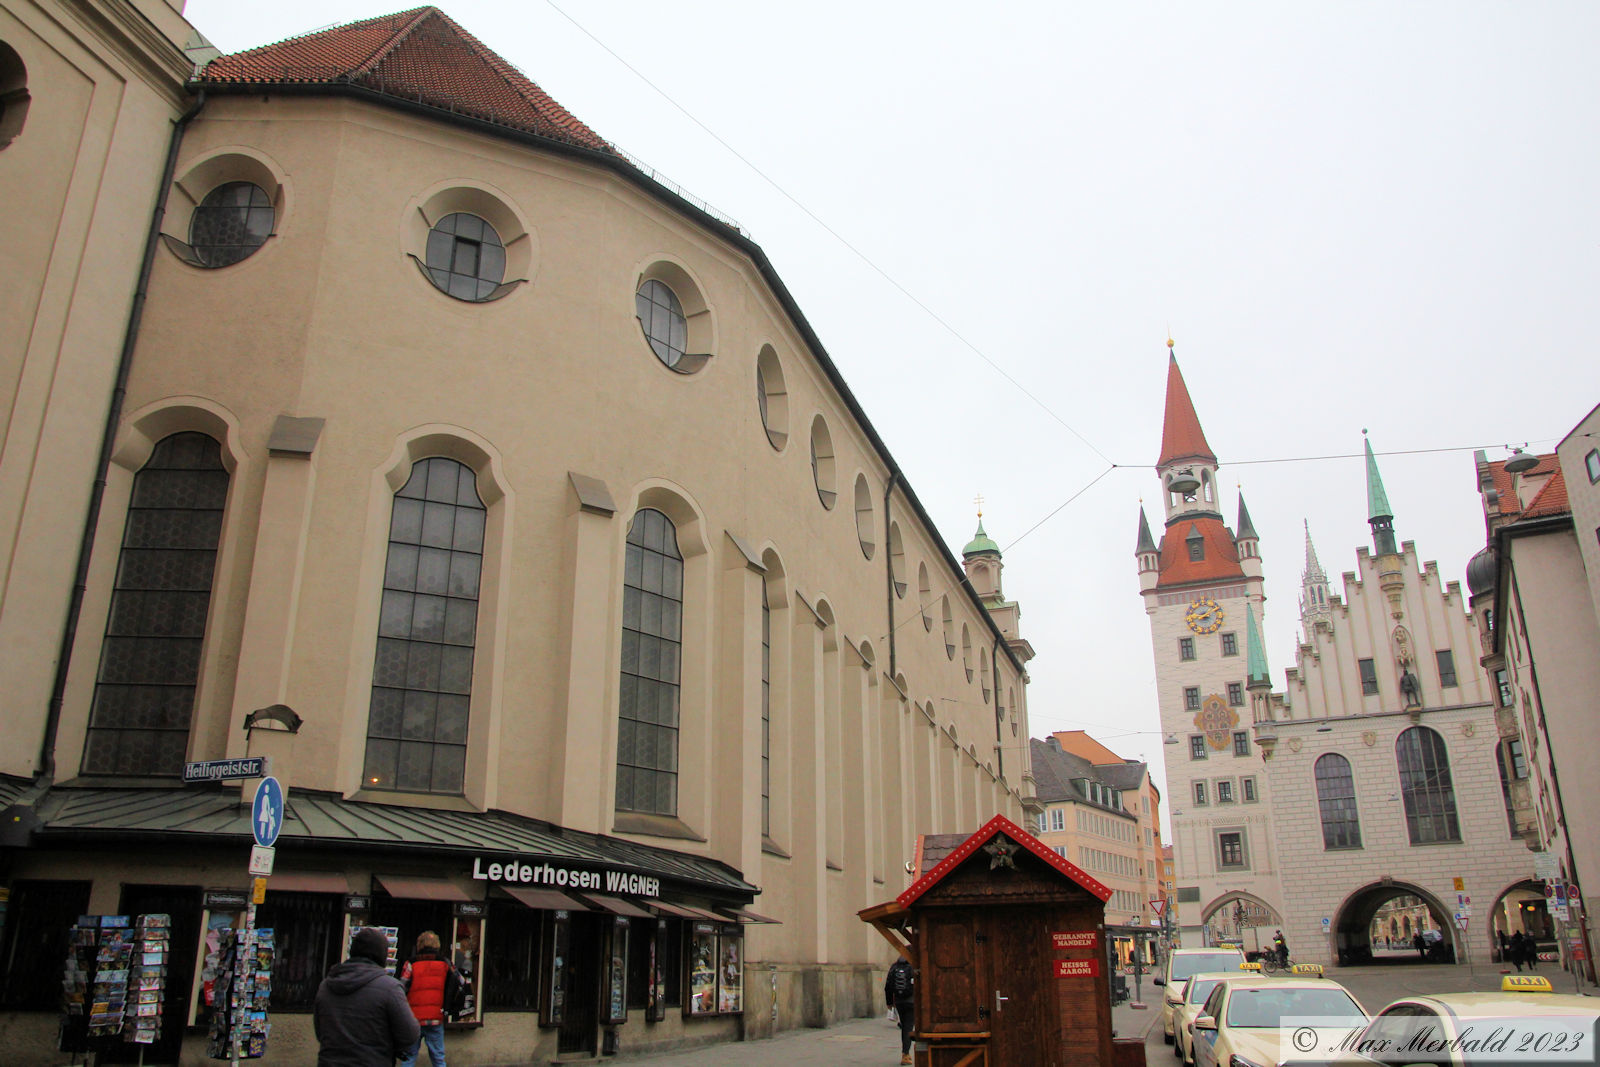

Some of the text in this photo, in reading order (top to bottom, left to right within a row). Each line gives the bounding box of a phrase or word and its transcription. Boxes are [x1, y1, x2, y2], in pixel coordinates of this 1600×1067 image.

[185, 761, 259, 779] Heiliggeiststr.
[472, 857, 660, 897] Lederhosen WAGNER
[1510, 976, 1546, 985] TAXI
